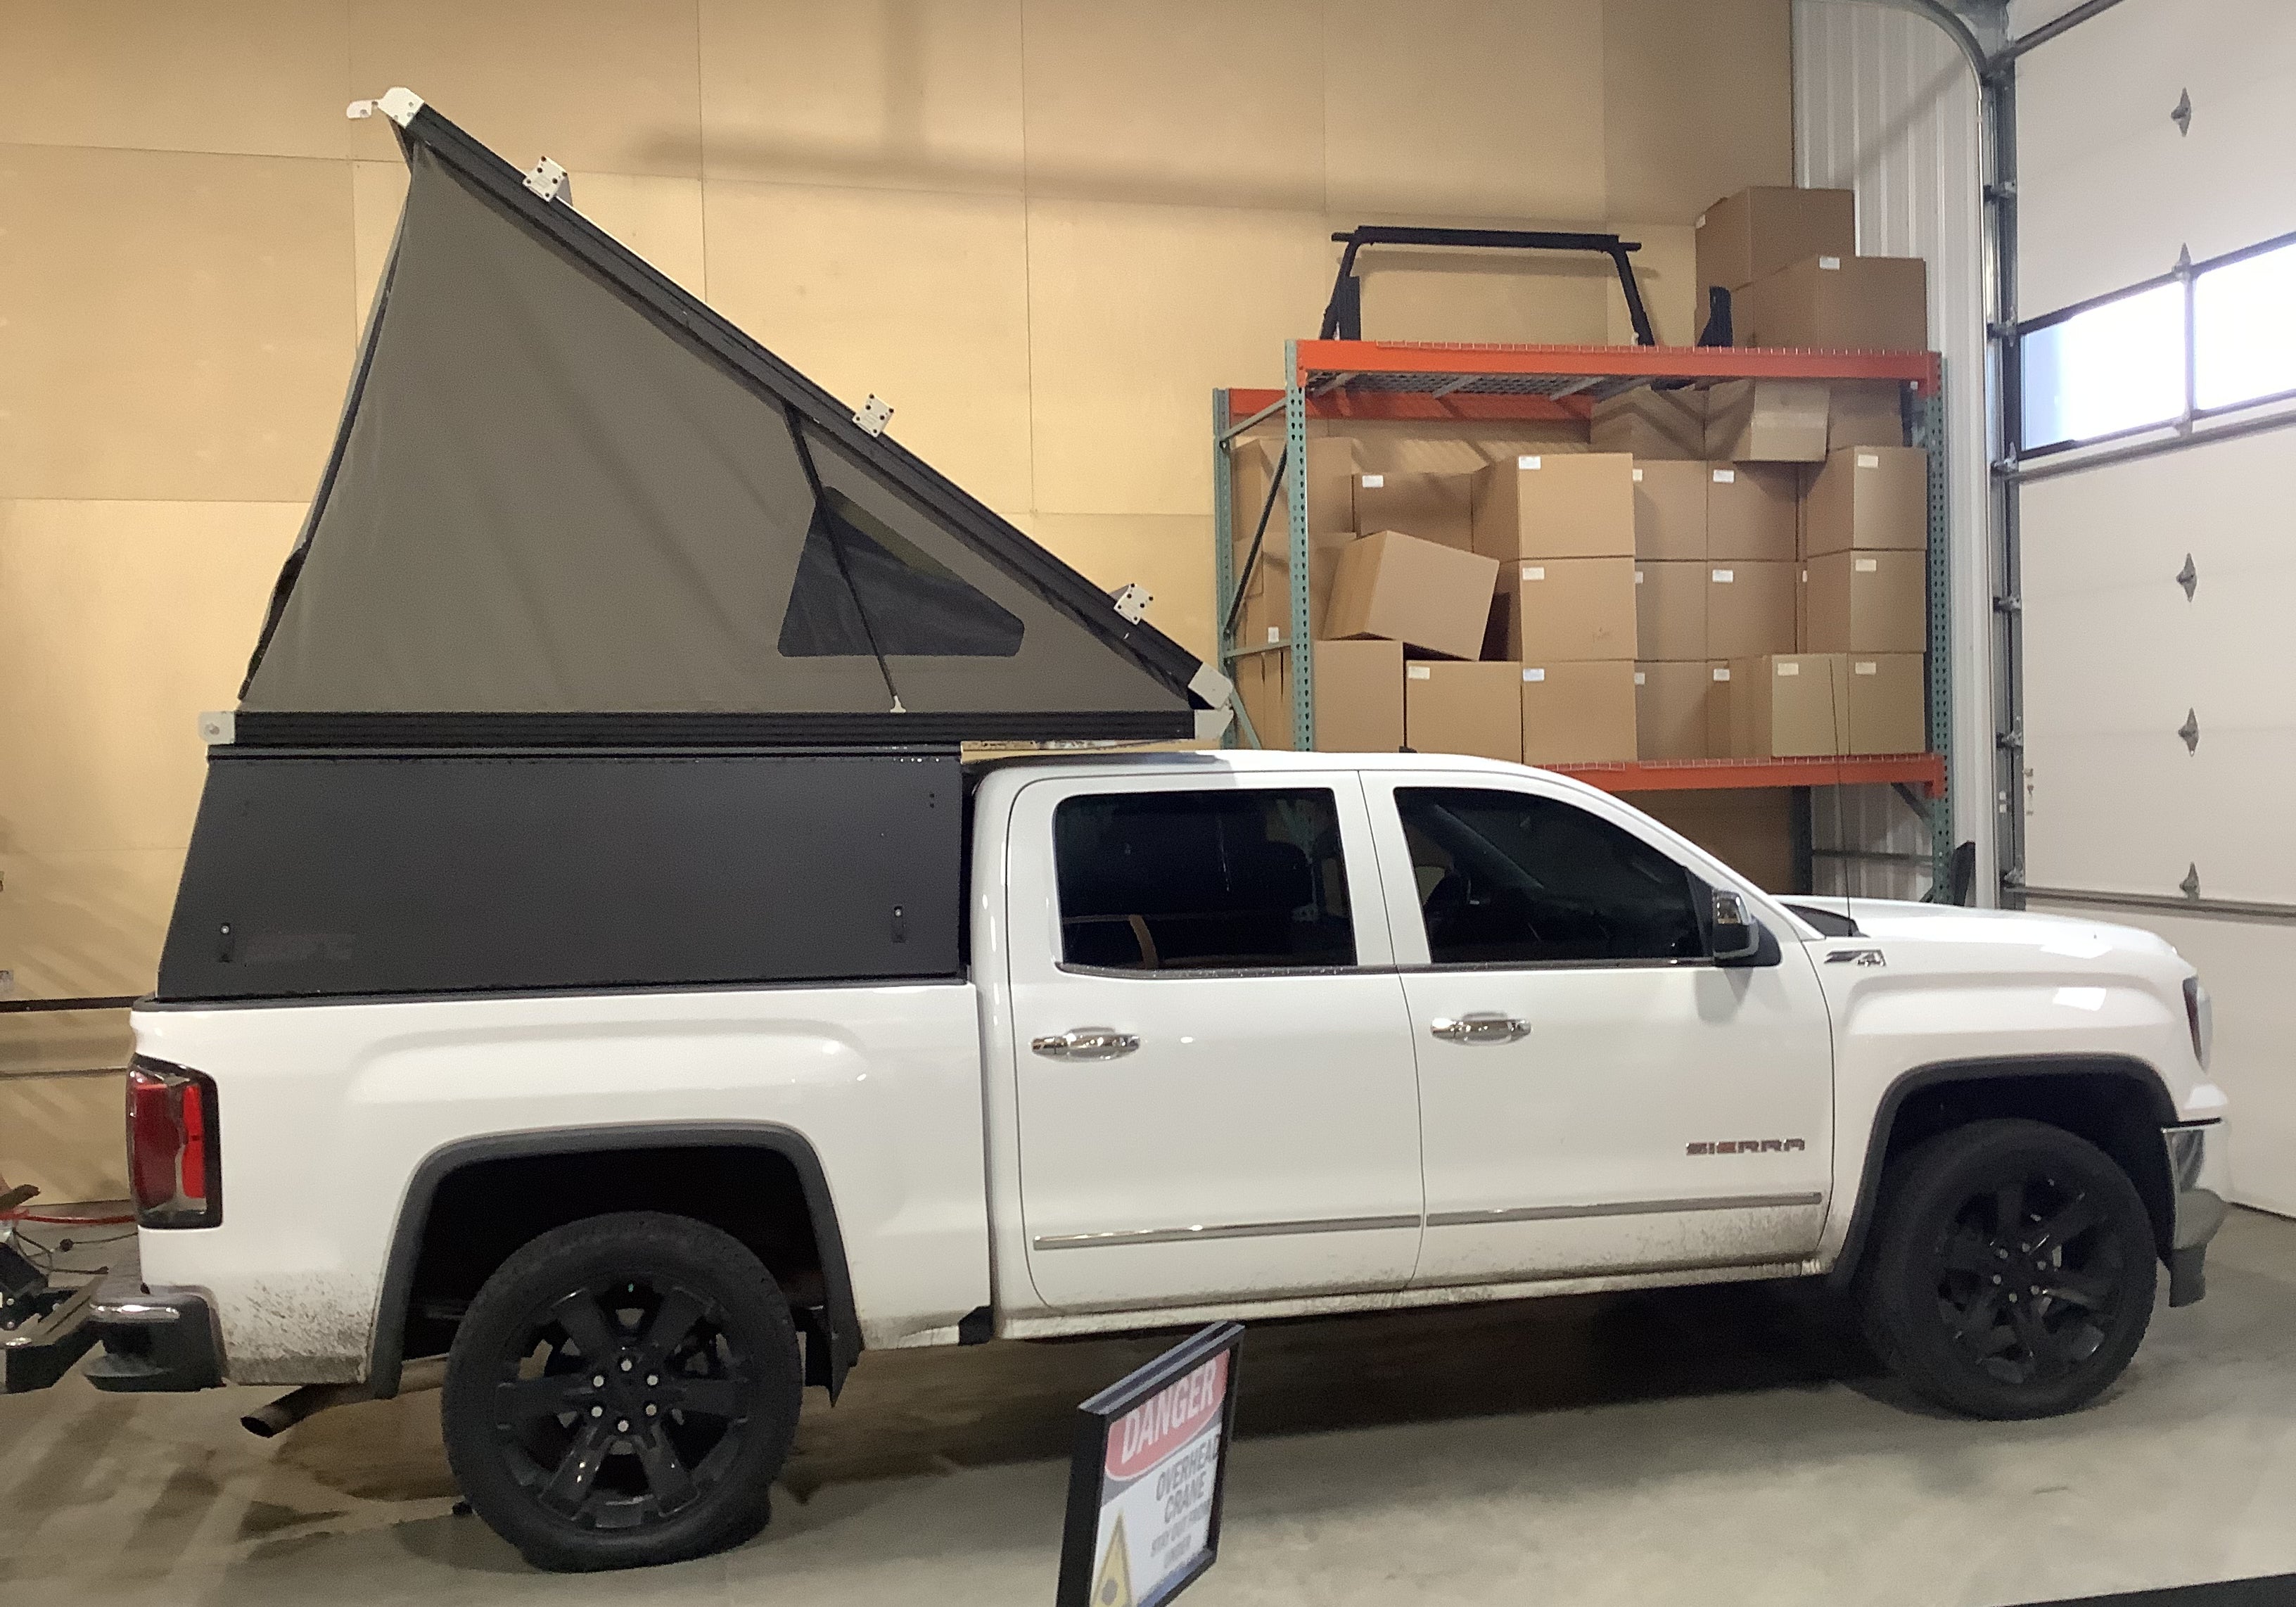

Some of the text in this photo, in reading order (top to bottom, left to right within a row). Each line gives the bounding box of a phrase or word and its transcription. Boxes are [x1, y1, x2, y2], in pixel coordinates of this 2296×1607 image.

[1686, 1138, 1805, 1155] SIERRA
[1121, 1358, 1216, 1464] DANGER
[1164, 1471, 1206, 1523] CRANE
